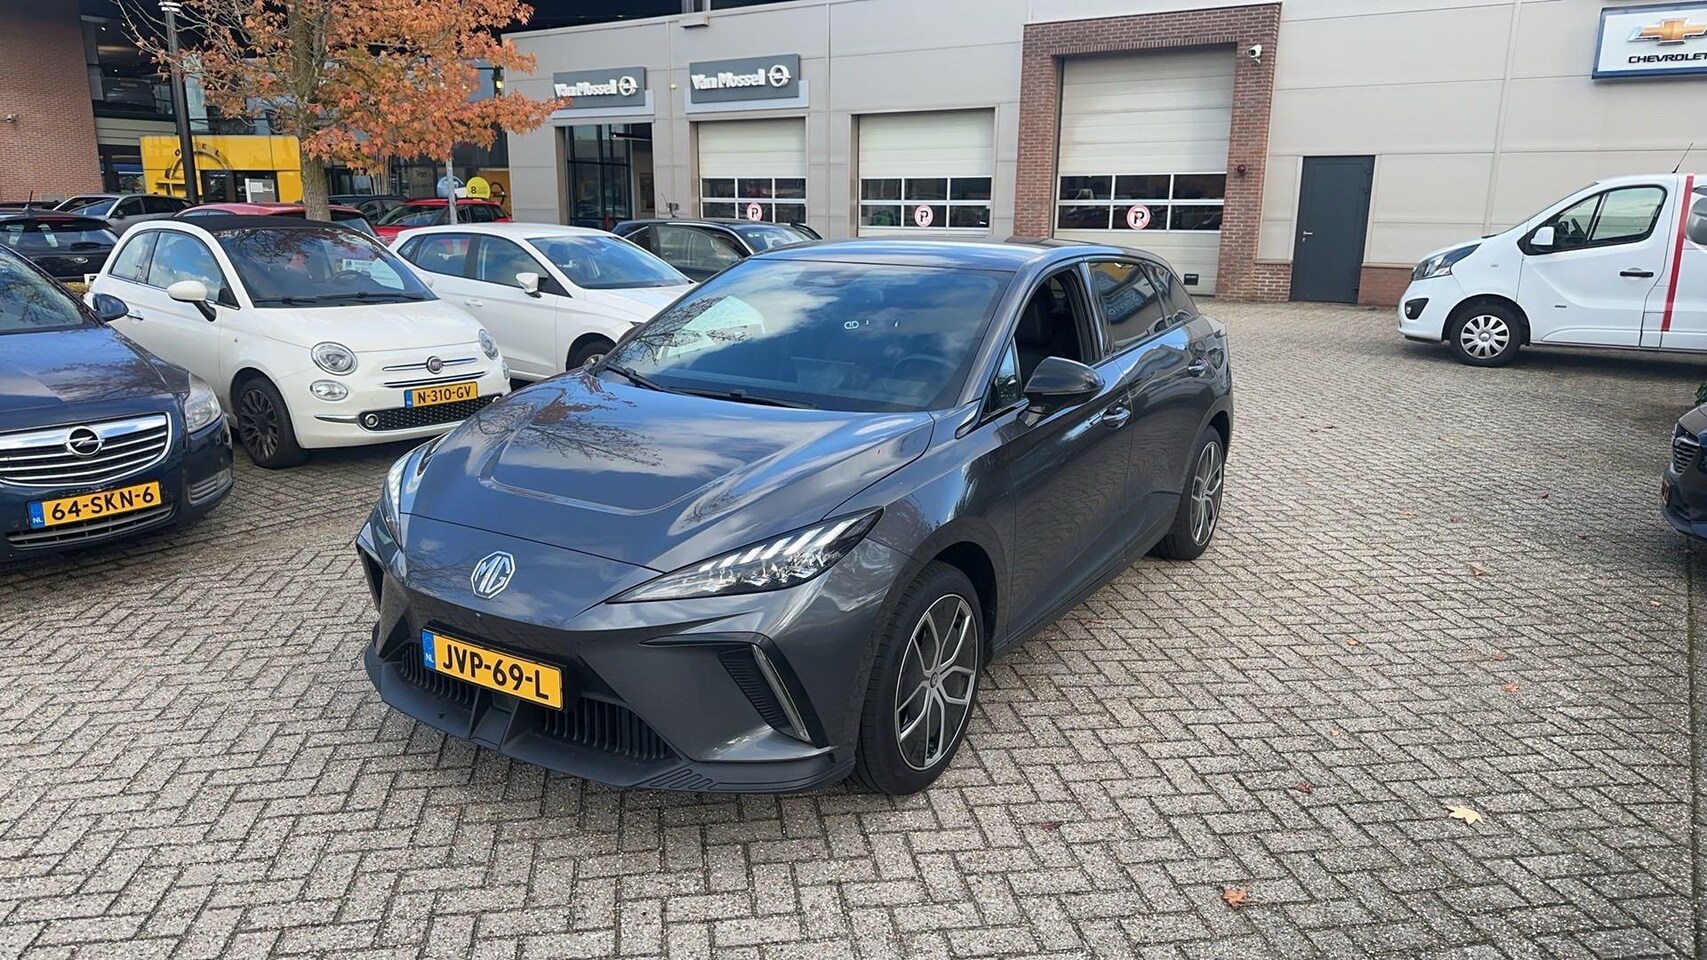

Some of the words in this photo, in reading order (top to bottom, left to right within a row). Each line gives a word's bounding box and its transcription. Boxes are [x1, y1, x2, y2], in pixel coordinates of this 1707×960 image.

[554, 83, 576, 97] Van
[691, 74, 718, 90] Van
[174, 143, 220, 157] OEL
[1133, 210, 1145, 225] P
[418, 386, 471, 404] N-310-GV
[51, 486, 154, 520] 64-SKN-6
[474, 555, 511, 594] MG
[425, 652, 434, 663] NL
[443, 644, 549, 700] JVP-69-L
